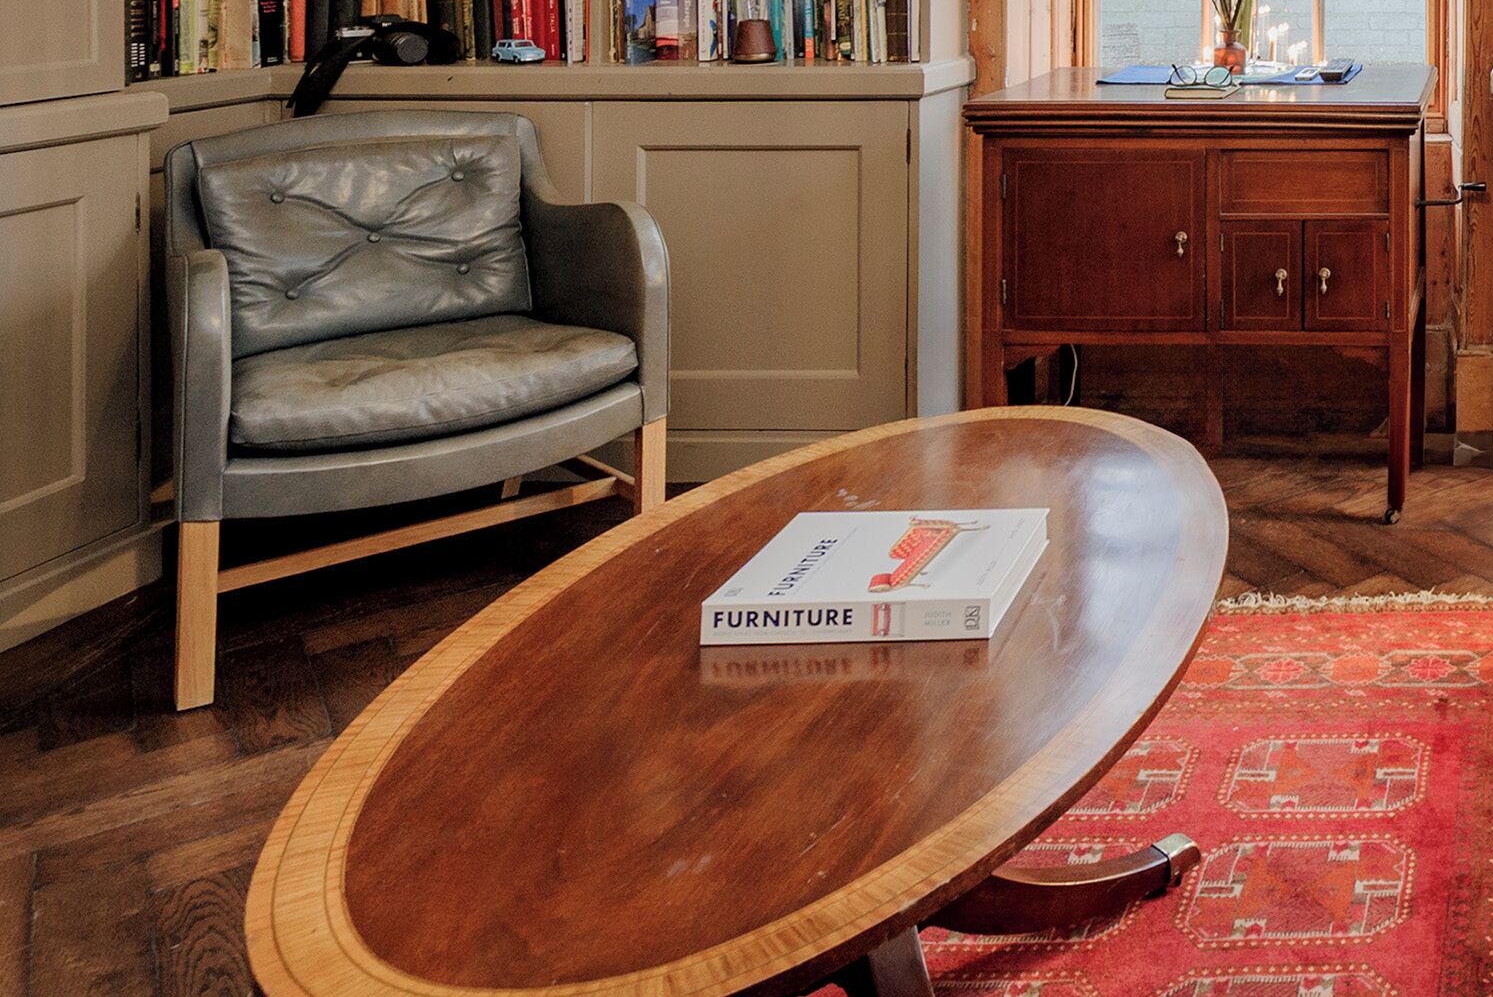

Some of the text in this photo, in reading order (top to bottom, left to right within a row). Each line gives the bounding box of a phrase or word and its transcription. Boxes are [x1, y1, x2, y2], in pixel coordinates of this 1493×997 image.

[768, 538, 838, 596] FURNITURE
[713, 608, 853, 628] FURNITURE
[965, 606, 980, 630] DK
